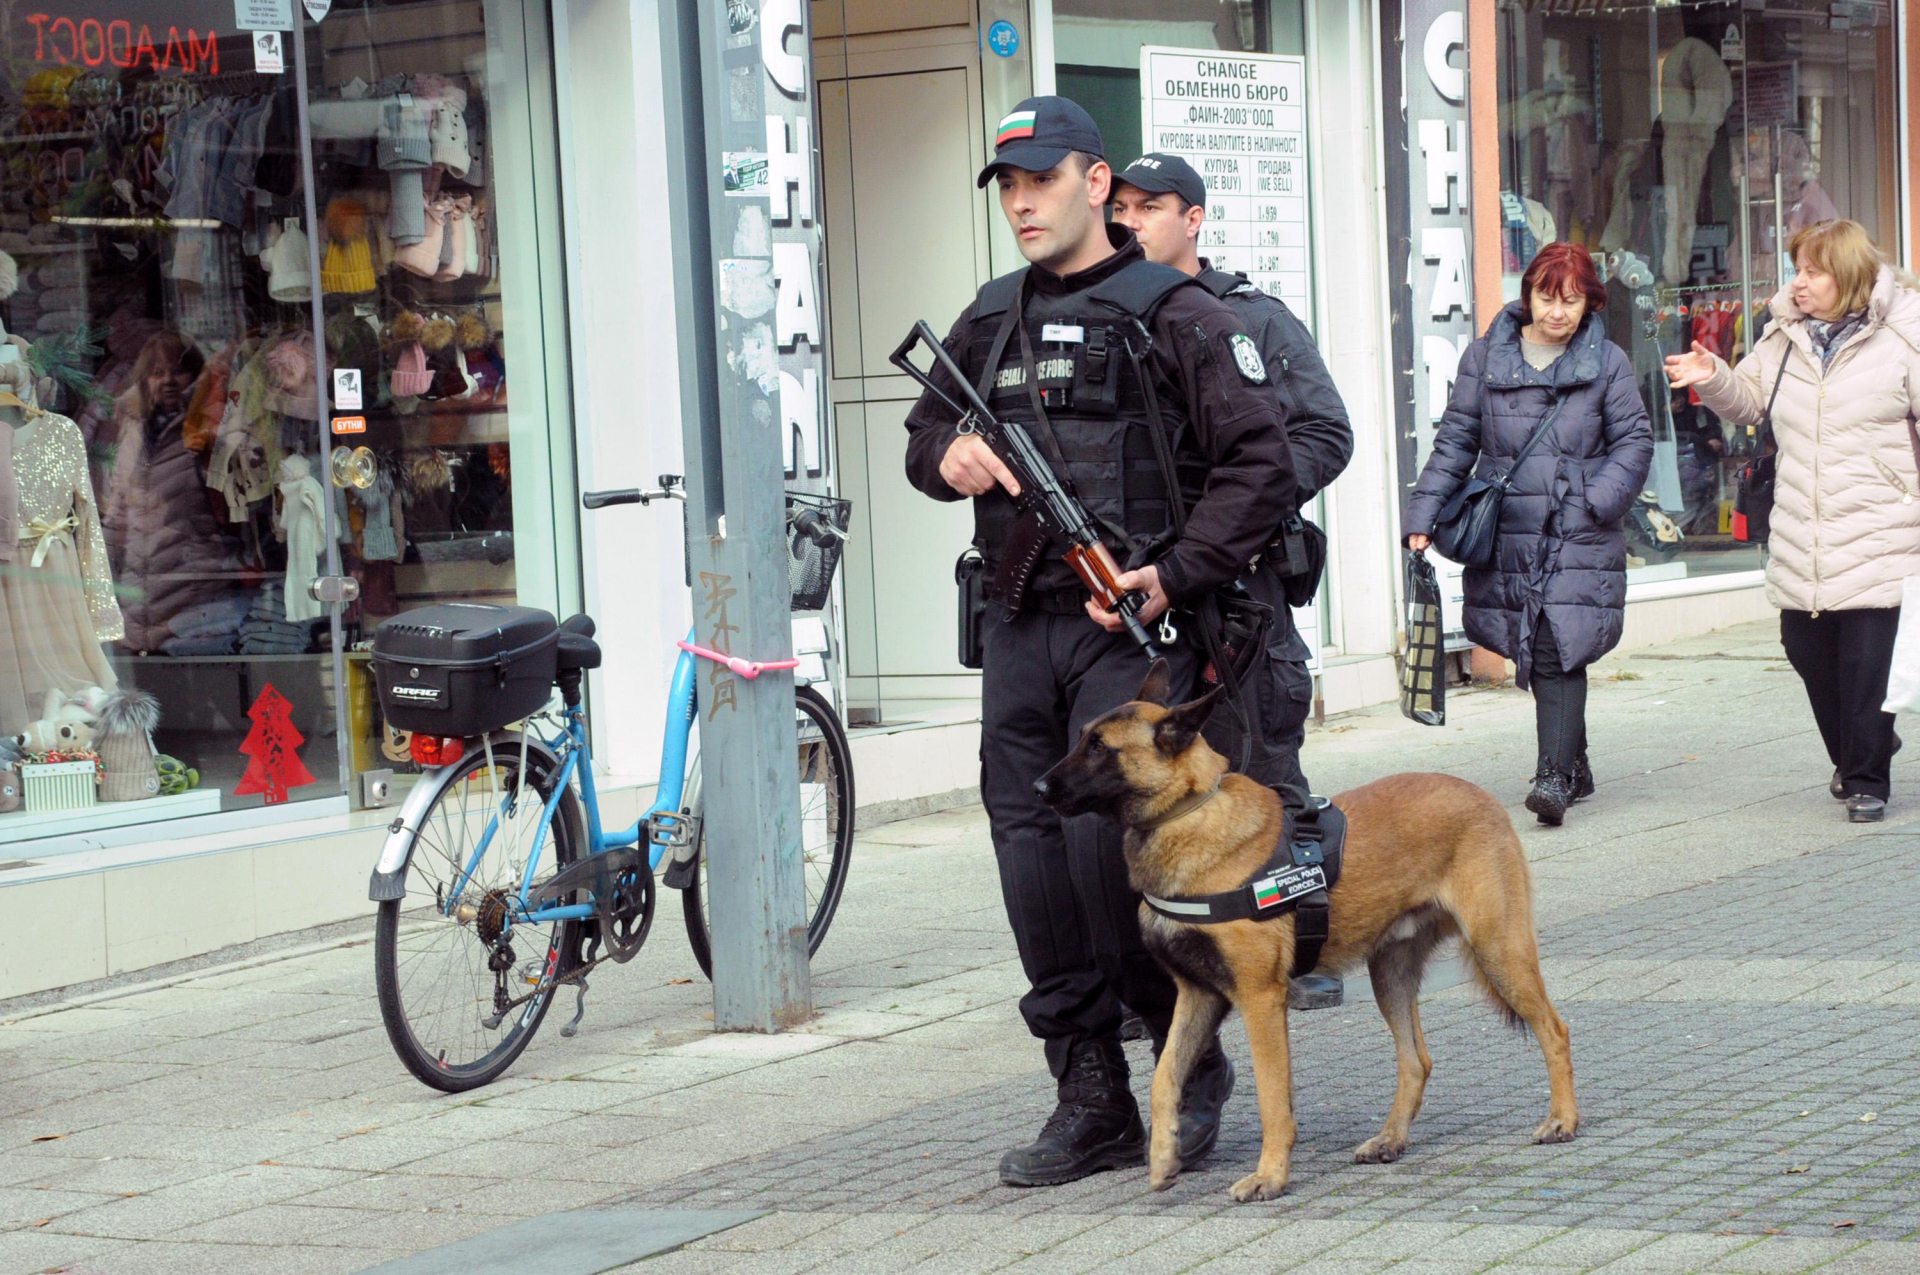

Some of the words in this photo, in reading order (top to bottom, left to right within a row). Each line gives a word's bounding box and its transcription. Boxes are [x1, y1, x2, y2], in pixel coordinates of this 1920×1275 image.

[1197, 60, 1258, 80] CHANGE
[1165, 79, 1241, 99] ОБМЕННО
[1246, 84, 1289, 102] БЮРО
[1160, 132, 1194, 150] КУРСОВЕ
[1196, 134, 1206, 150] НА
[1208, 134, 1245, 151] ВАЛУТИТЕ
[1247, 136, 1252, 151] В
[1254, 136, 1297, 153] НАЛИЧНОСТ
[1204, 158, 1239, 174] КУПУВА
[1258, 160, 1292, 176] ПРОДАВА
[757, 169, 768, 186] 42
[1221, 176, 1242, 192] BUY)
[1257, 177, 1271, 192] (WE
[1273, 178, 1293, 194] SELL)
[336, 420, 363, 431] БУТНИ
[392, 686, 441, 697] DRAG
[1277, 874, 1301, 888] SPECIAL
[1288, 878, 1315, 894] FORCES
